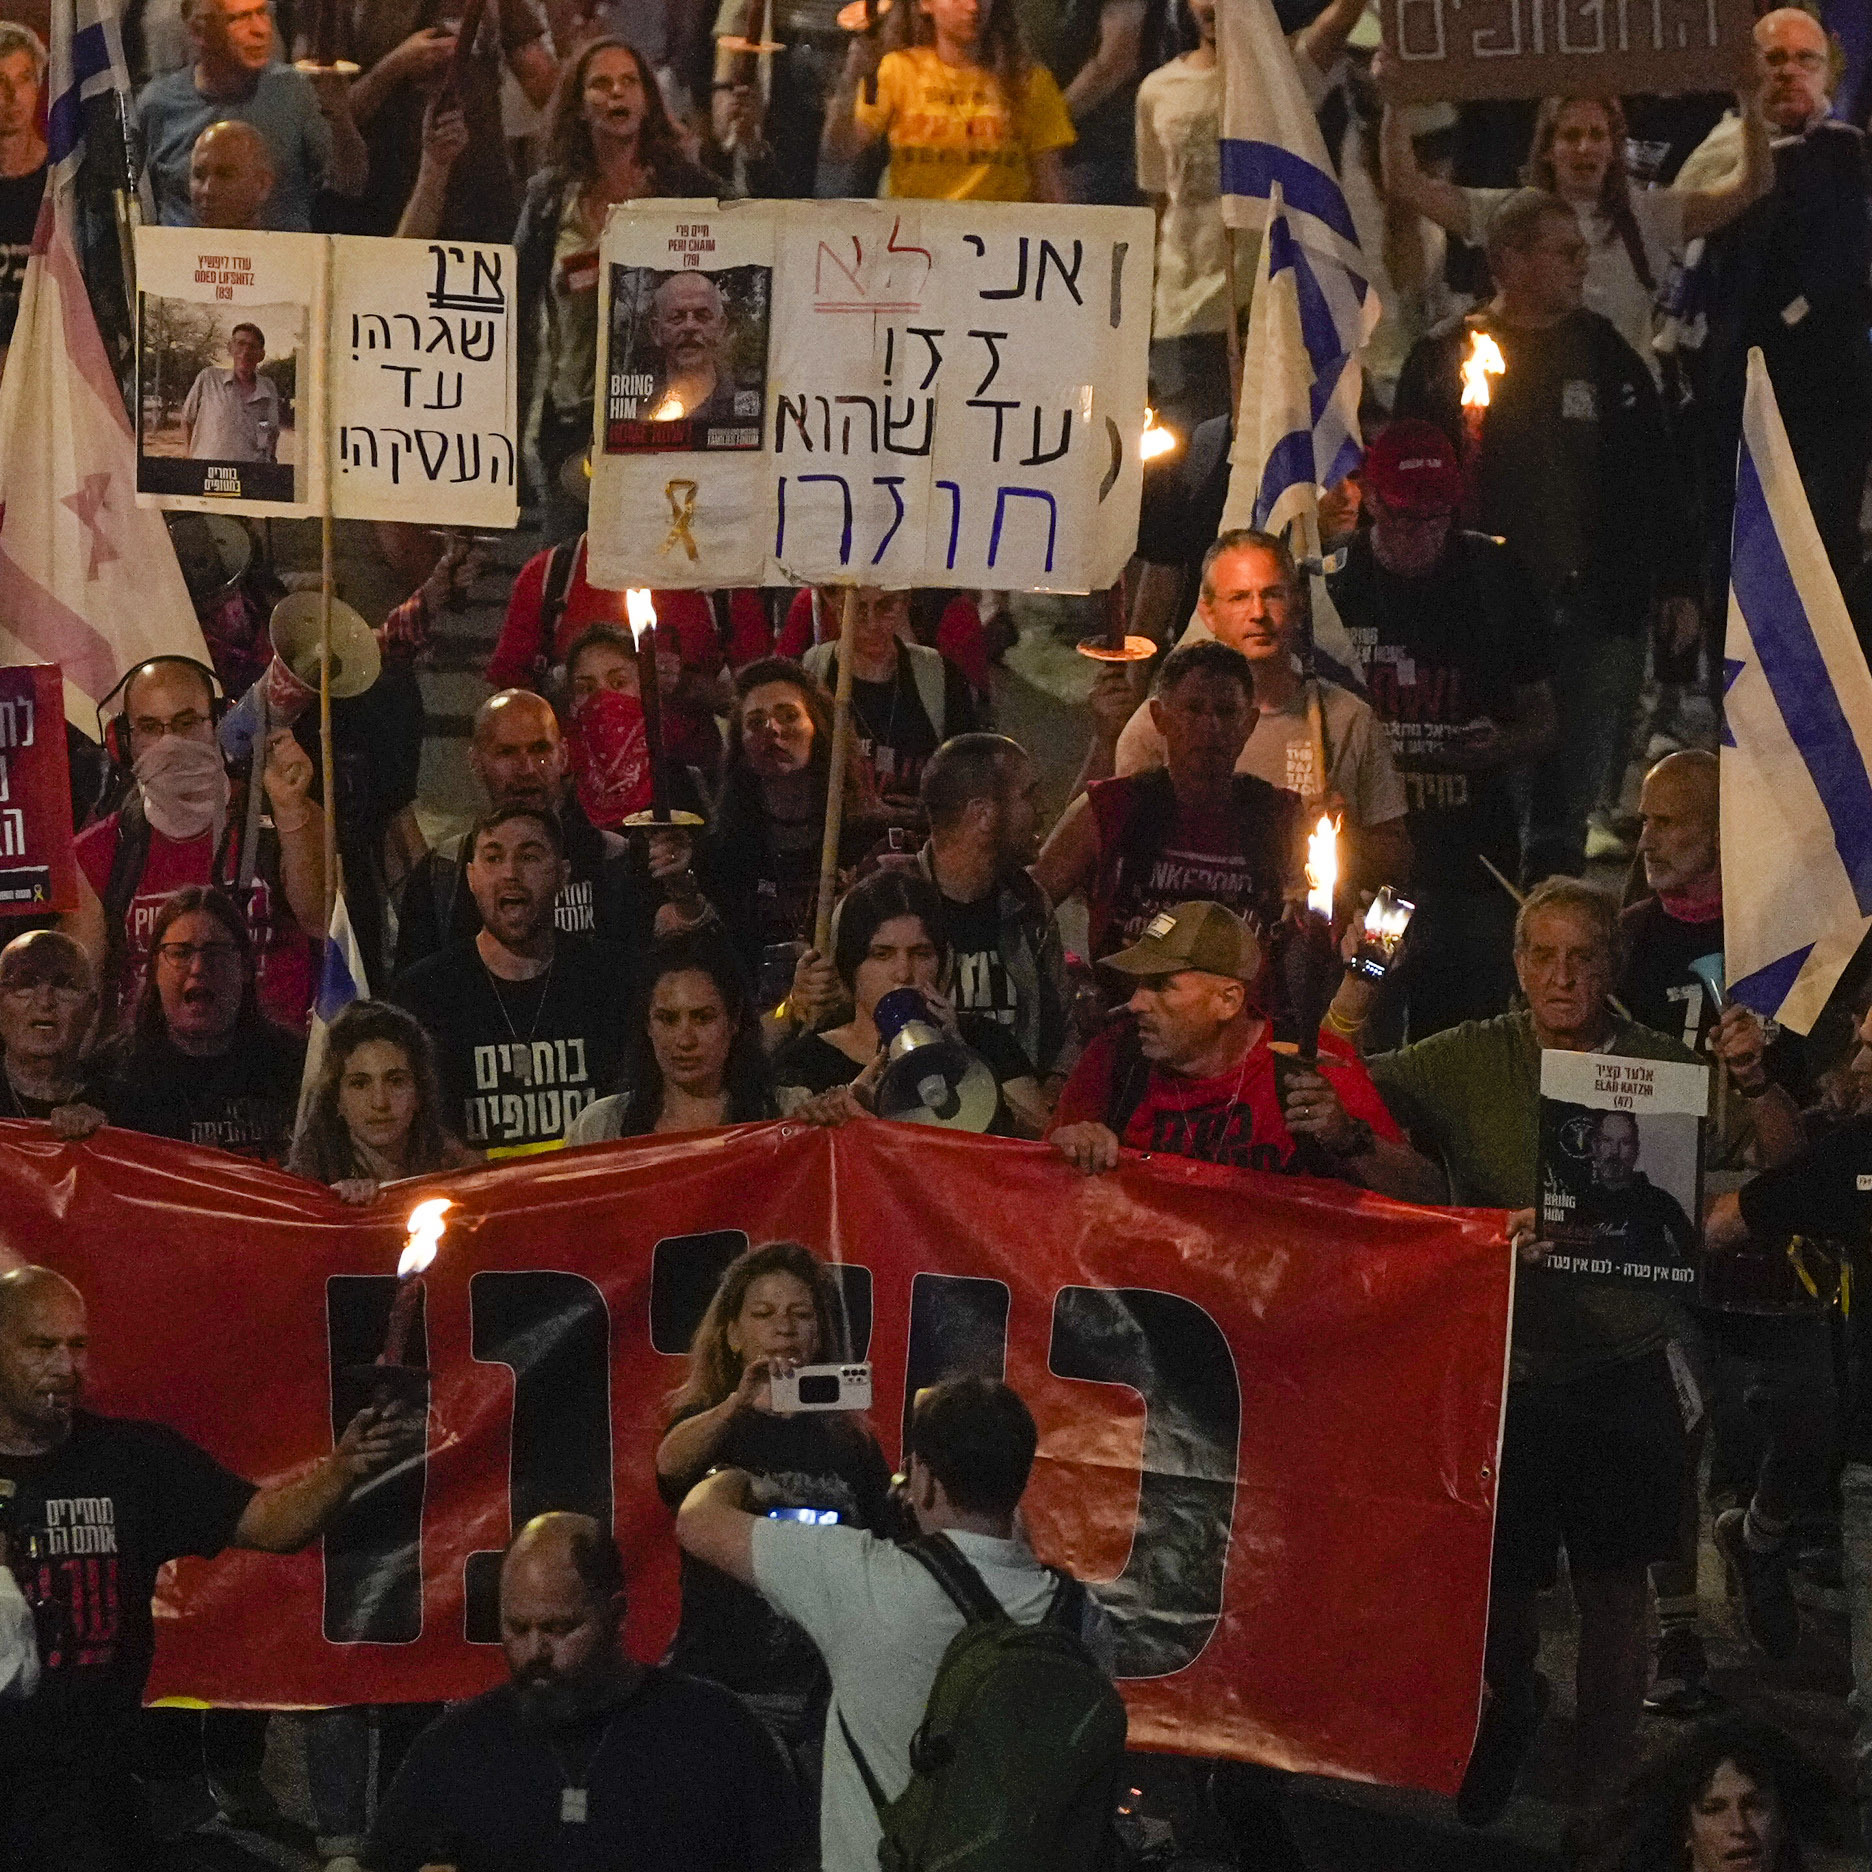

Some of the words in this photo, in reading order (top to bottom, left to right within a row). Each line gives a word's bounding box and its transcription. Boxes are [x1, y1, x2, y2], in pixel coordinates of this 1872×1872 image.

[668, 239, 687, 252] PERI
[194, 270, 216, 284] ODED
[427, 245, 505, 305] אין
[962, 234, 1084, 306] אני
[352, 313, 495, 361] שגרה!
[380, 364, 463, 410] עד
[609, 397, 638, 420] HIM
[610, 374, 654, 397] BRING
[775, 393, 934, 456] שהוא
[966, 399, 1072, 467] עד
[340, 426, 514, 486] העסקה!
[472, 1037, 588, 1089] בוחים
[1543, 1192, 1576, 1209] BRING
[1543, 1208, 1565, 1222] HIM
